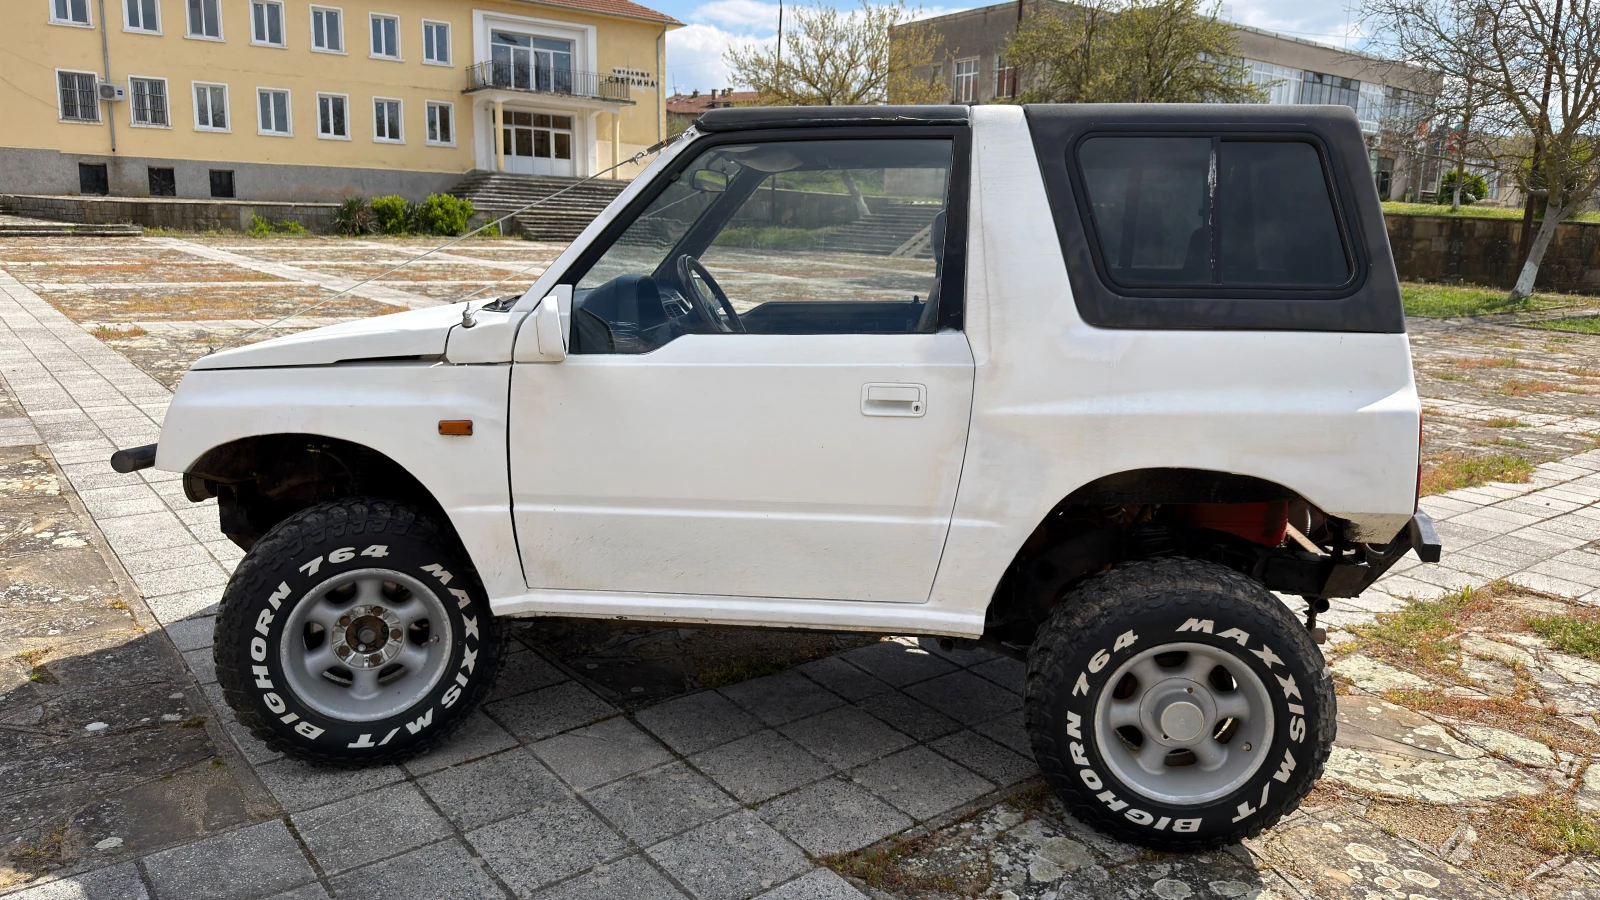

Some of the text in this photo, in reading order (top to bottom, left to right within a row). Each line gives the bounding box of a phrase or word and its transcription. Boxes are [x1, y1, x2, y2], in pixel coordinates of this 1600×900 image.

[250, 544, 390, 740] BIGHORN 764
[347, 563, 479, 749] MAXXIS M/T
[1066, 629, 1202, 833] BIGHORN 764
[1175, 617, 1306, 823] MAXXIS M/T
